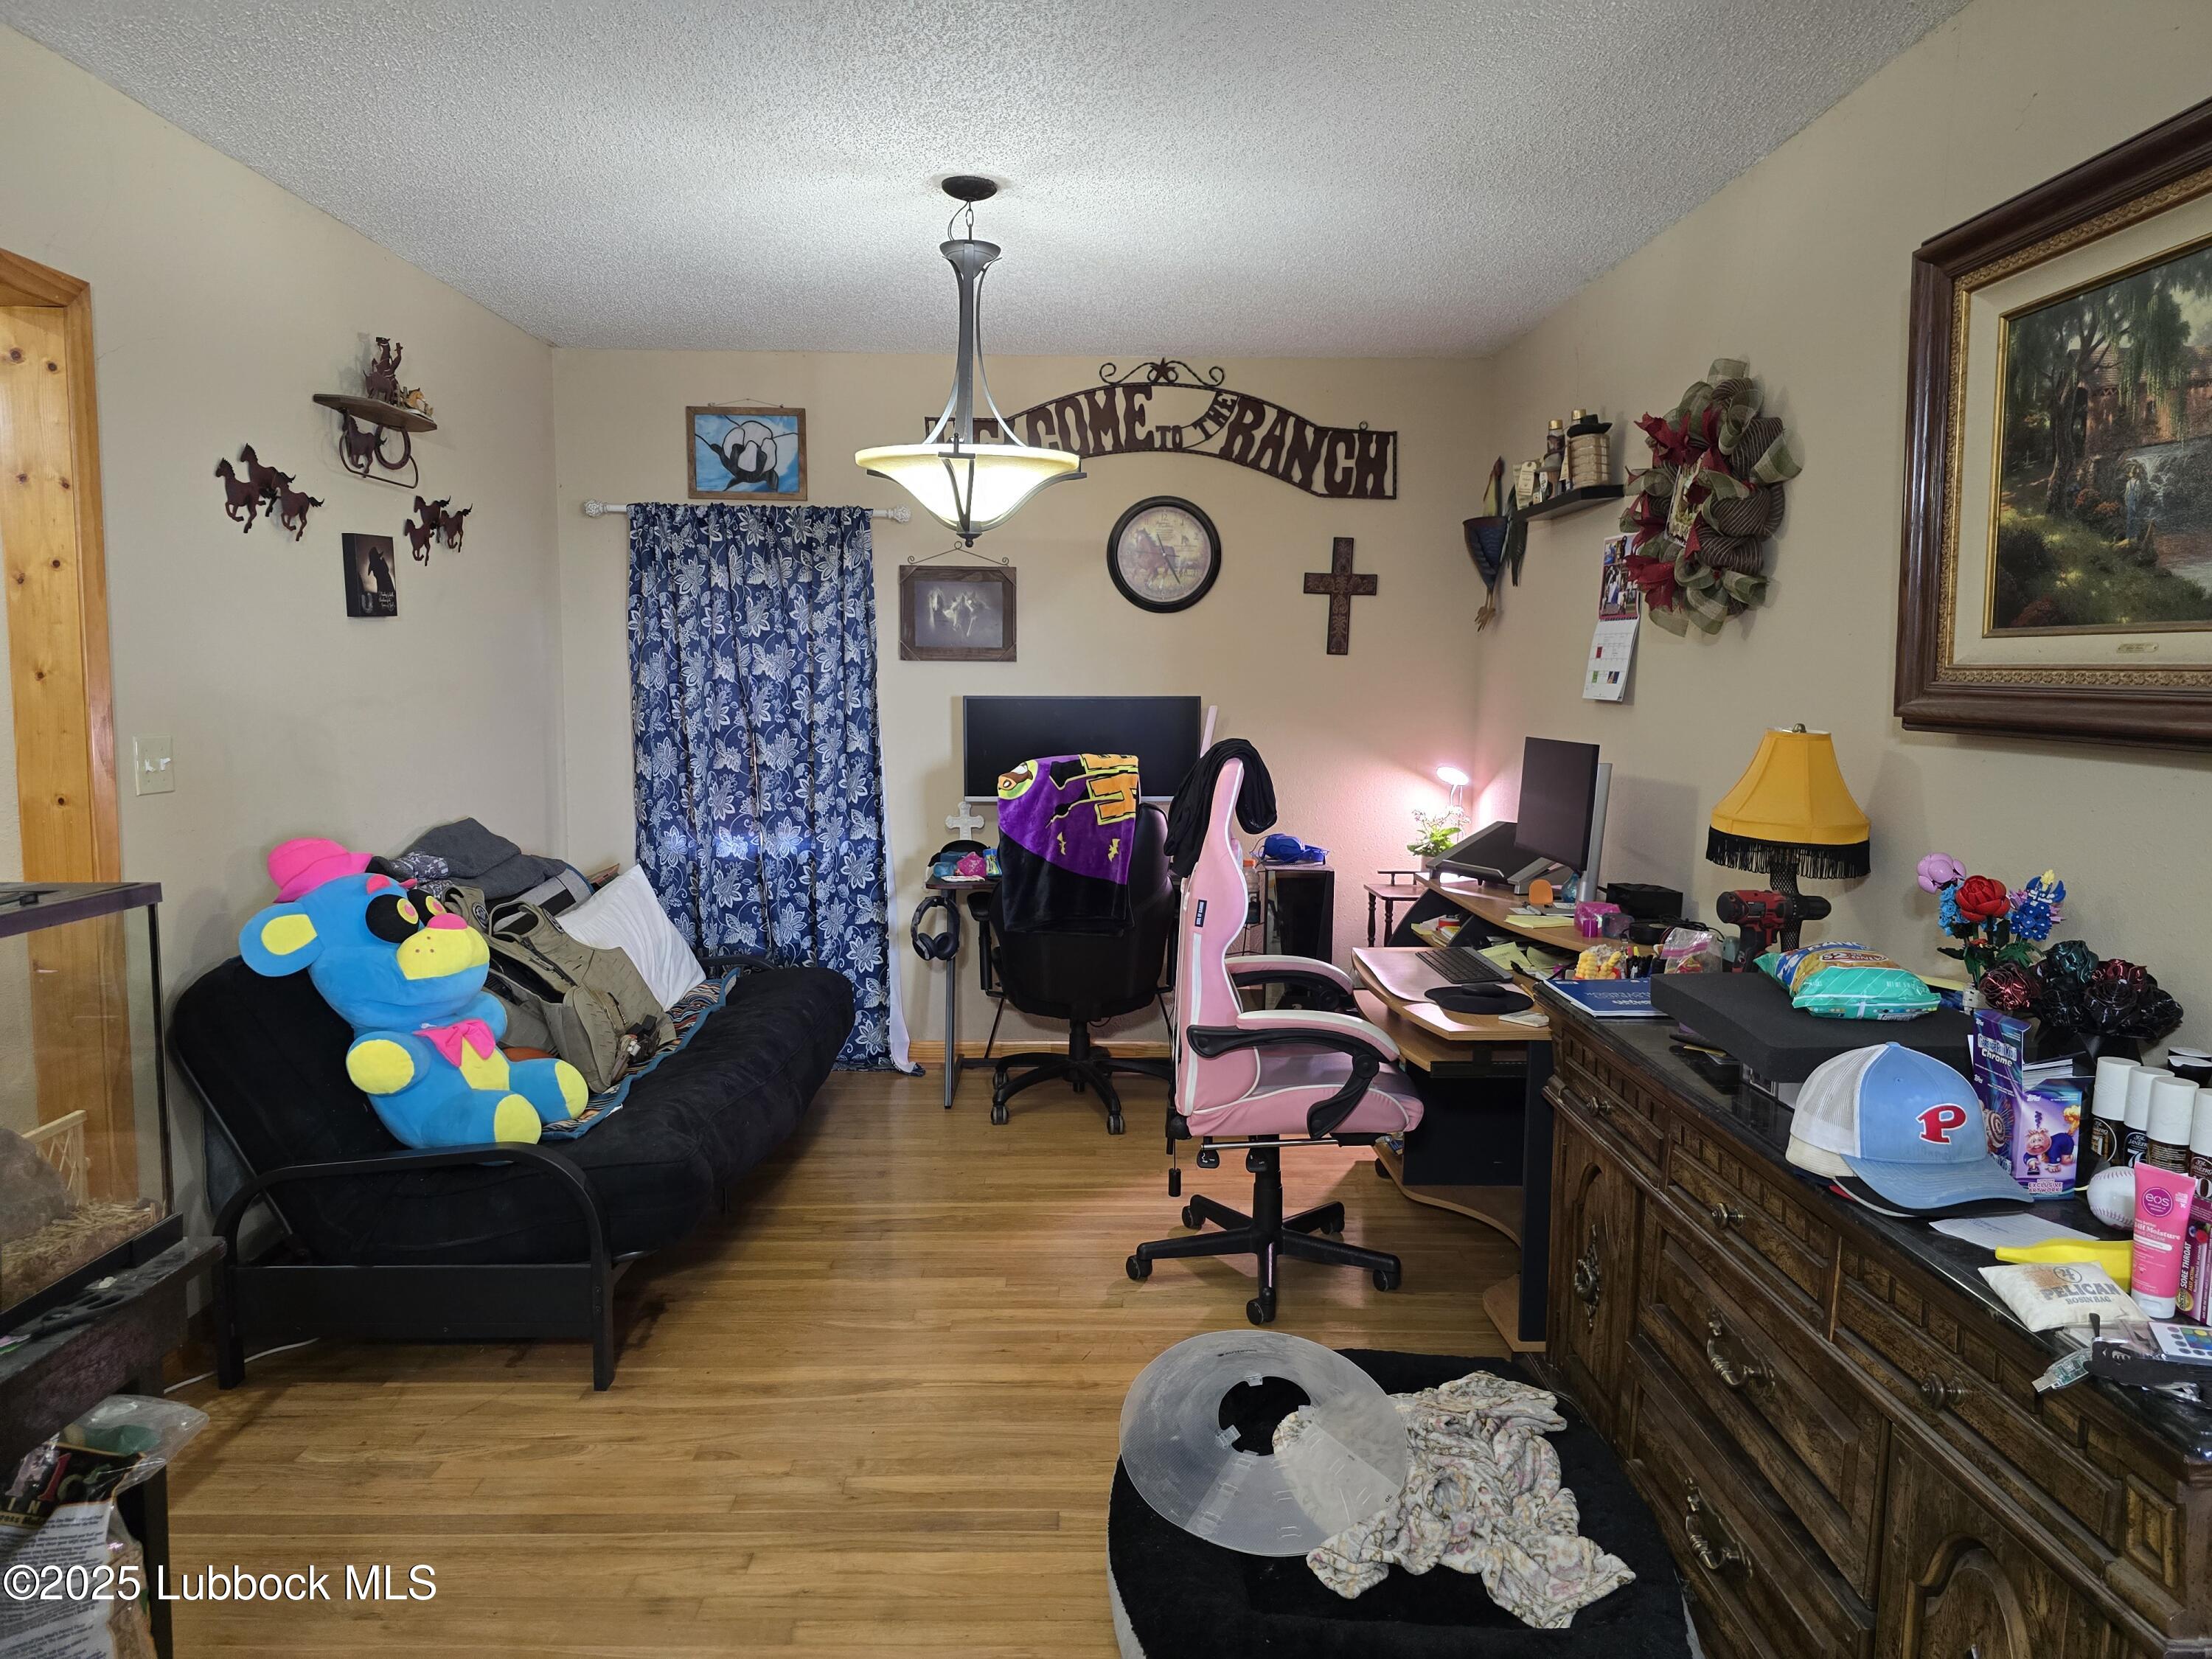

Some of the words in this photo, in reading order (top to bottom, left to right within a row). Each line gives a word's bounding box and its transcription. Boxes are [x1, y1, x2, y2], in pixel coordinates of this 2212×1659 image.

[932, 384, 1155, 457] COME
[1155, 425, 1183, 449] TO
[1192, 392, 1238, 440] THE
[1219, 395, 1391, 496] RANCH
[1981, 1048, 2013, 1067] Chrome
[1918, 1105, 1966, 1144] P
[2145, 1193, 2170, 1207] eos
[2146, 1225, 2180, 1240] Moisture
[2182, 1241, 2192, 1269] THROAT
[2180, 1270, 2188, 1289] SORE
[2040, 1282, 2121, 1301] PELICAN
[2065, 1296, 2093, 1304] ROSIN
